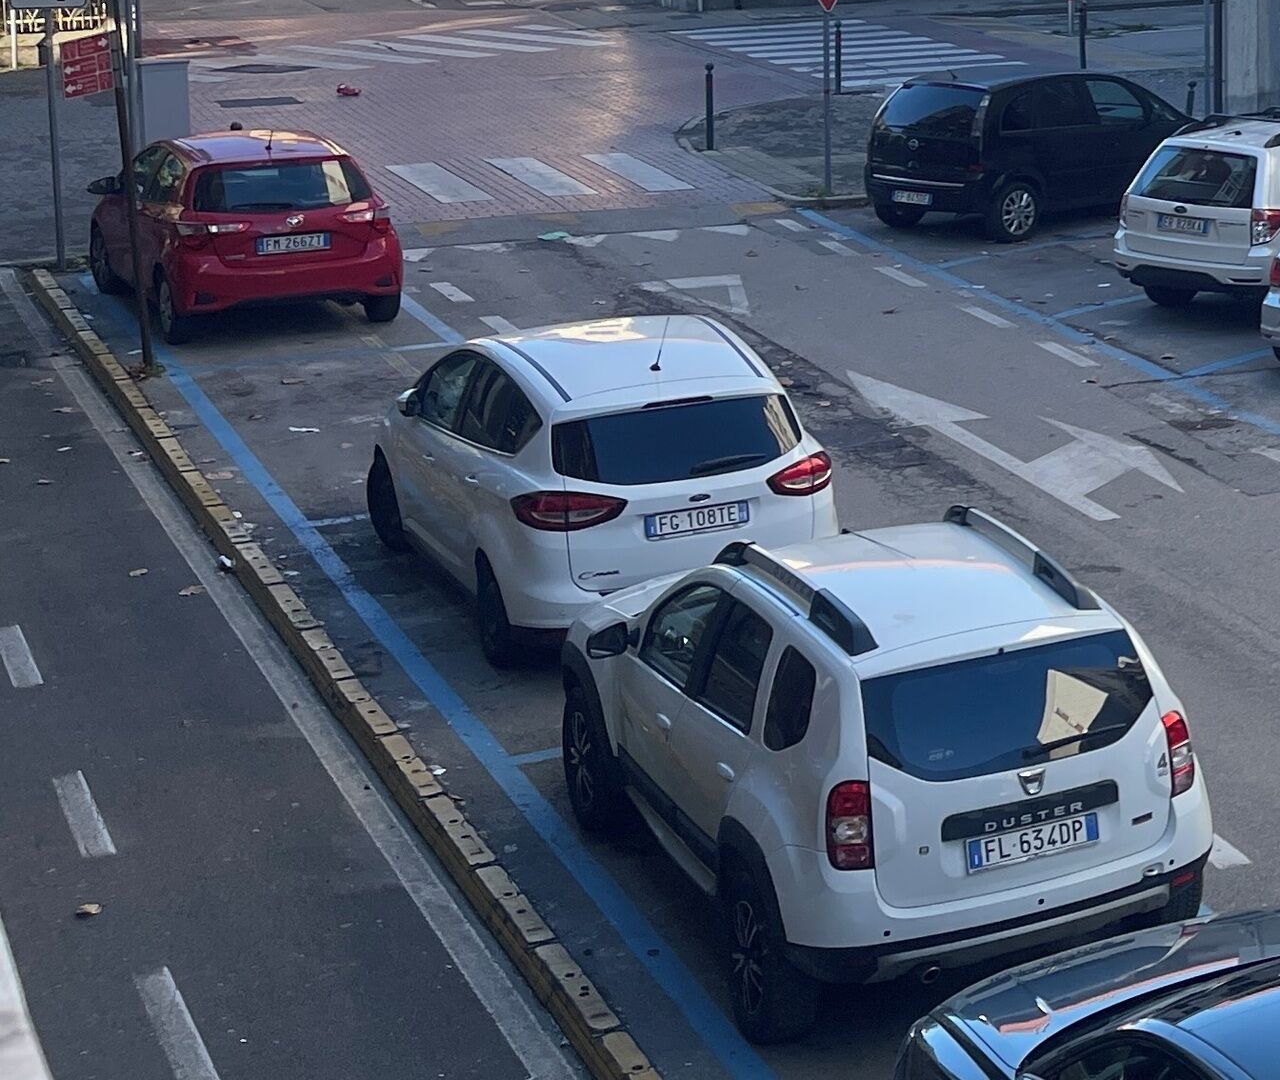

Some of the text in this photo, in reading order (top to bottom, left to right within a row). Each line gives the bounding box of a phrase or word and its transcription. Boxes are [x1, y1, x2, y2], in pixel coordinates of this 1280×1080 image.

[266, 238, 281, 250] FM
[658, 505, 737, 533] FG 108TE
[984, 801, 1084, 832] DUSTER
[984, 820, 1084, 863] FL 634DP
